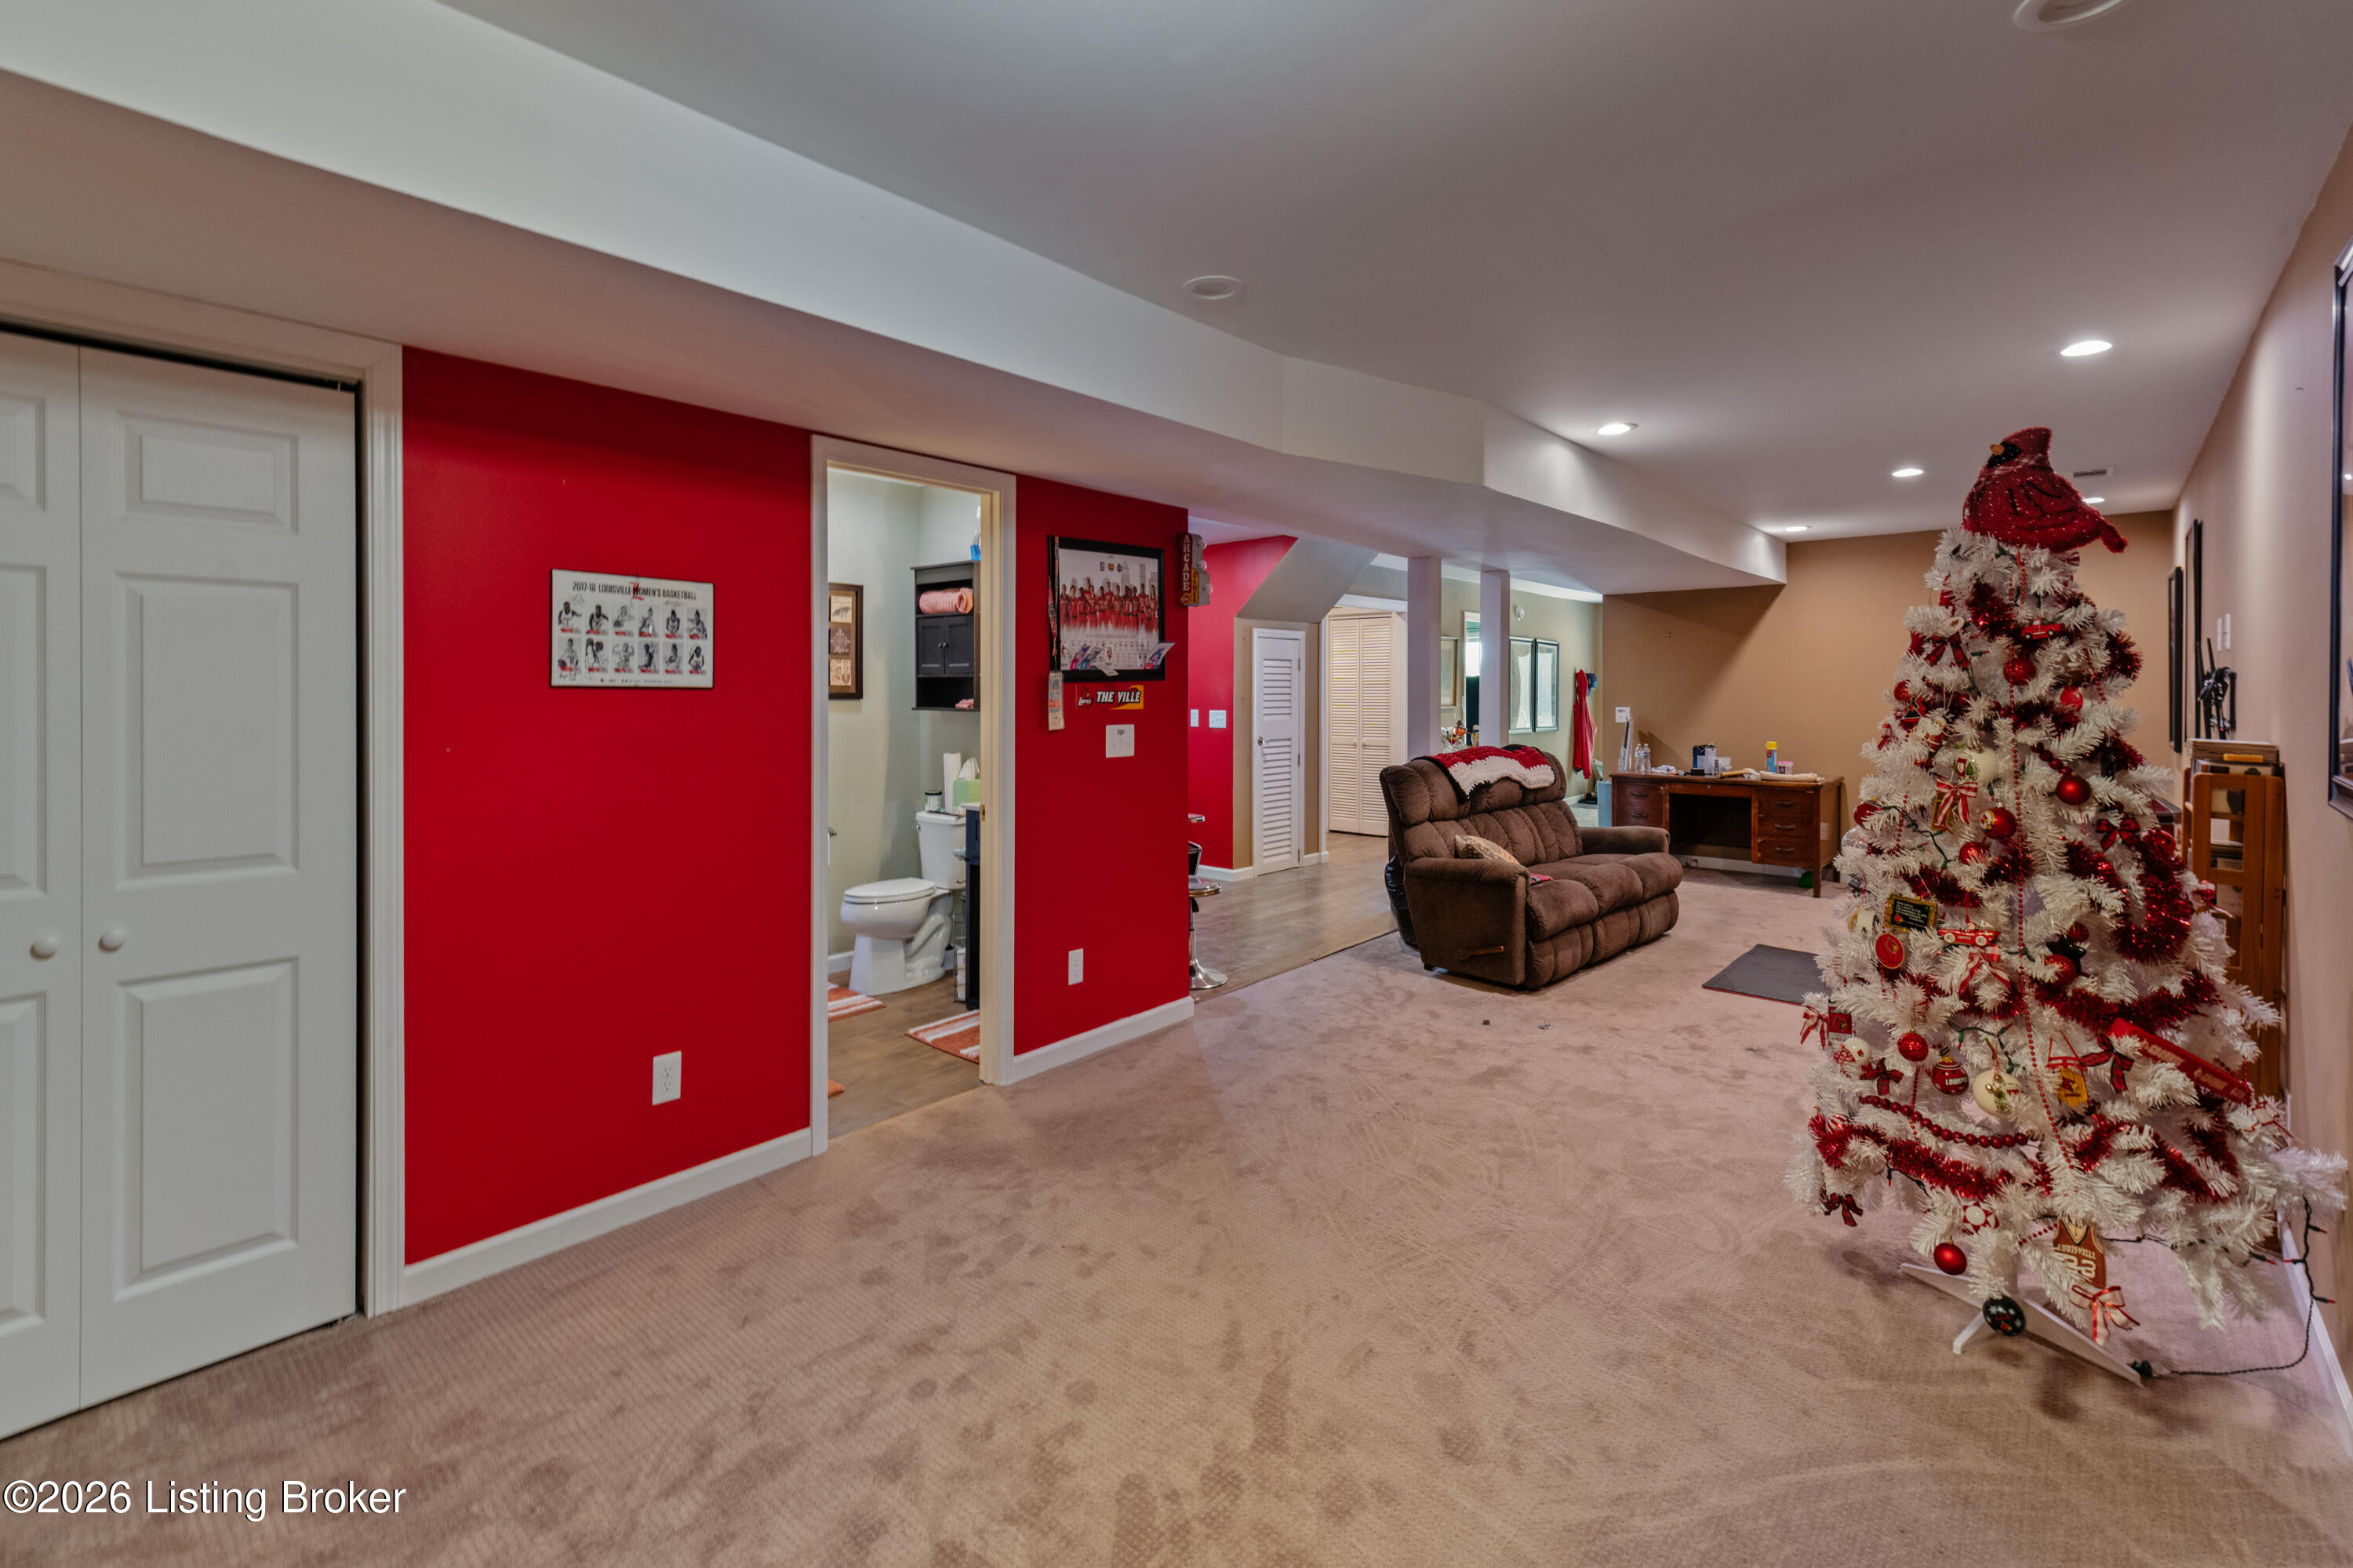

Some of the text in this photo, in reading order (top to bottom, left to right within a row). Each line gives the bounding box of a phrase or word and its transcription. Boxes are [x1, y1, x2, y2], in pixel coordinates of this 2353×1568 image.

[598, 584, 631, 595] LOUISVILLE
[633, 584, 661, 598] WOMEN'S
[662, 588, 696, 600] BASKETBALL
[1096, 691, 1115, 703] THE
[1118, 691, 1141, 703] VILLE
[2057, 1243, 2097, 1260] LOUISVILLE
